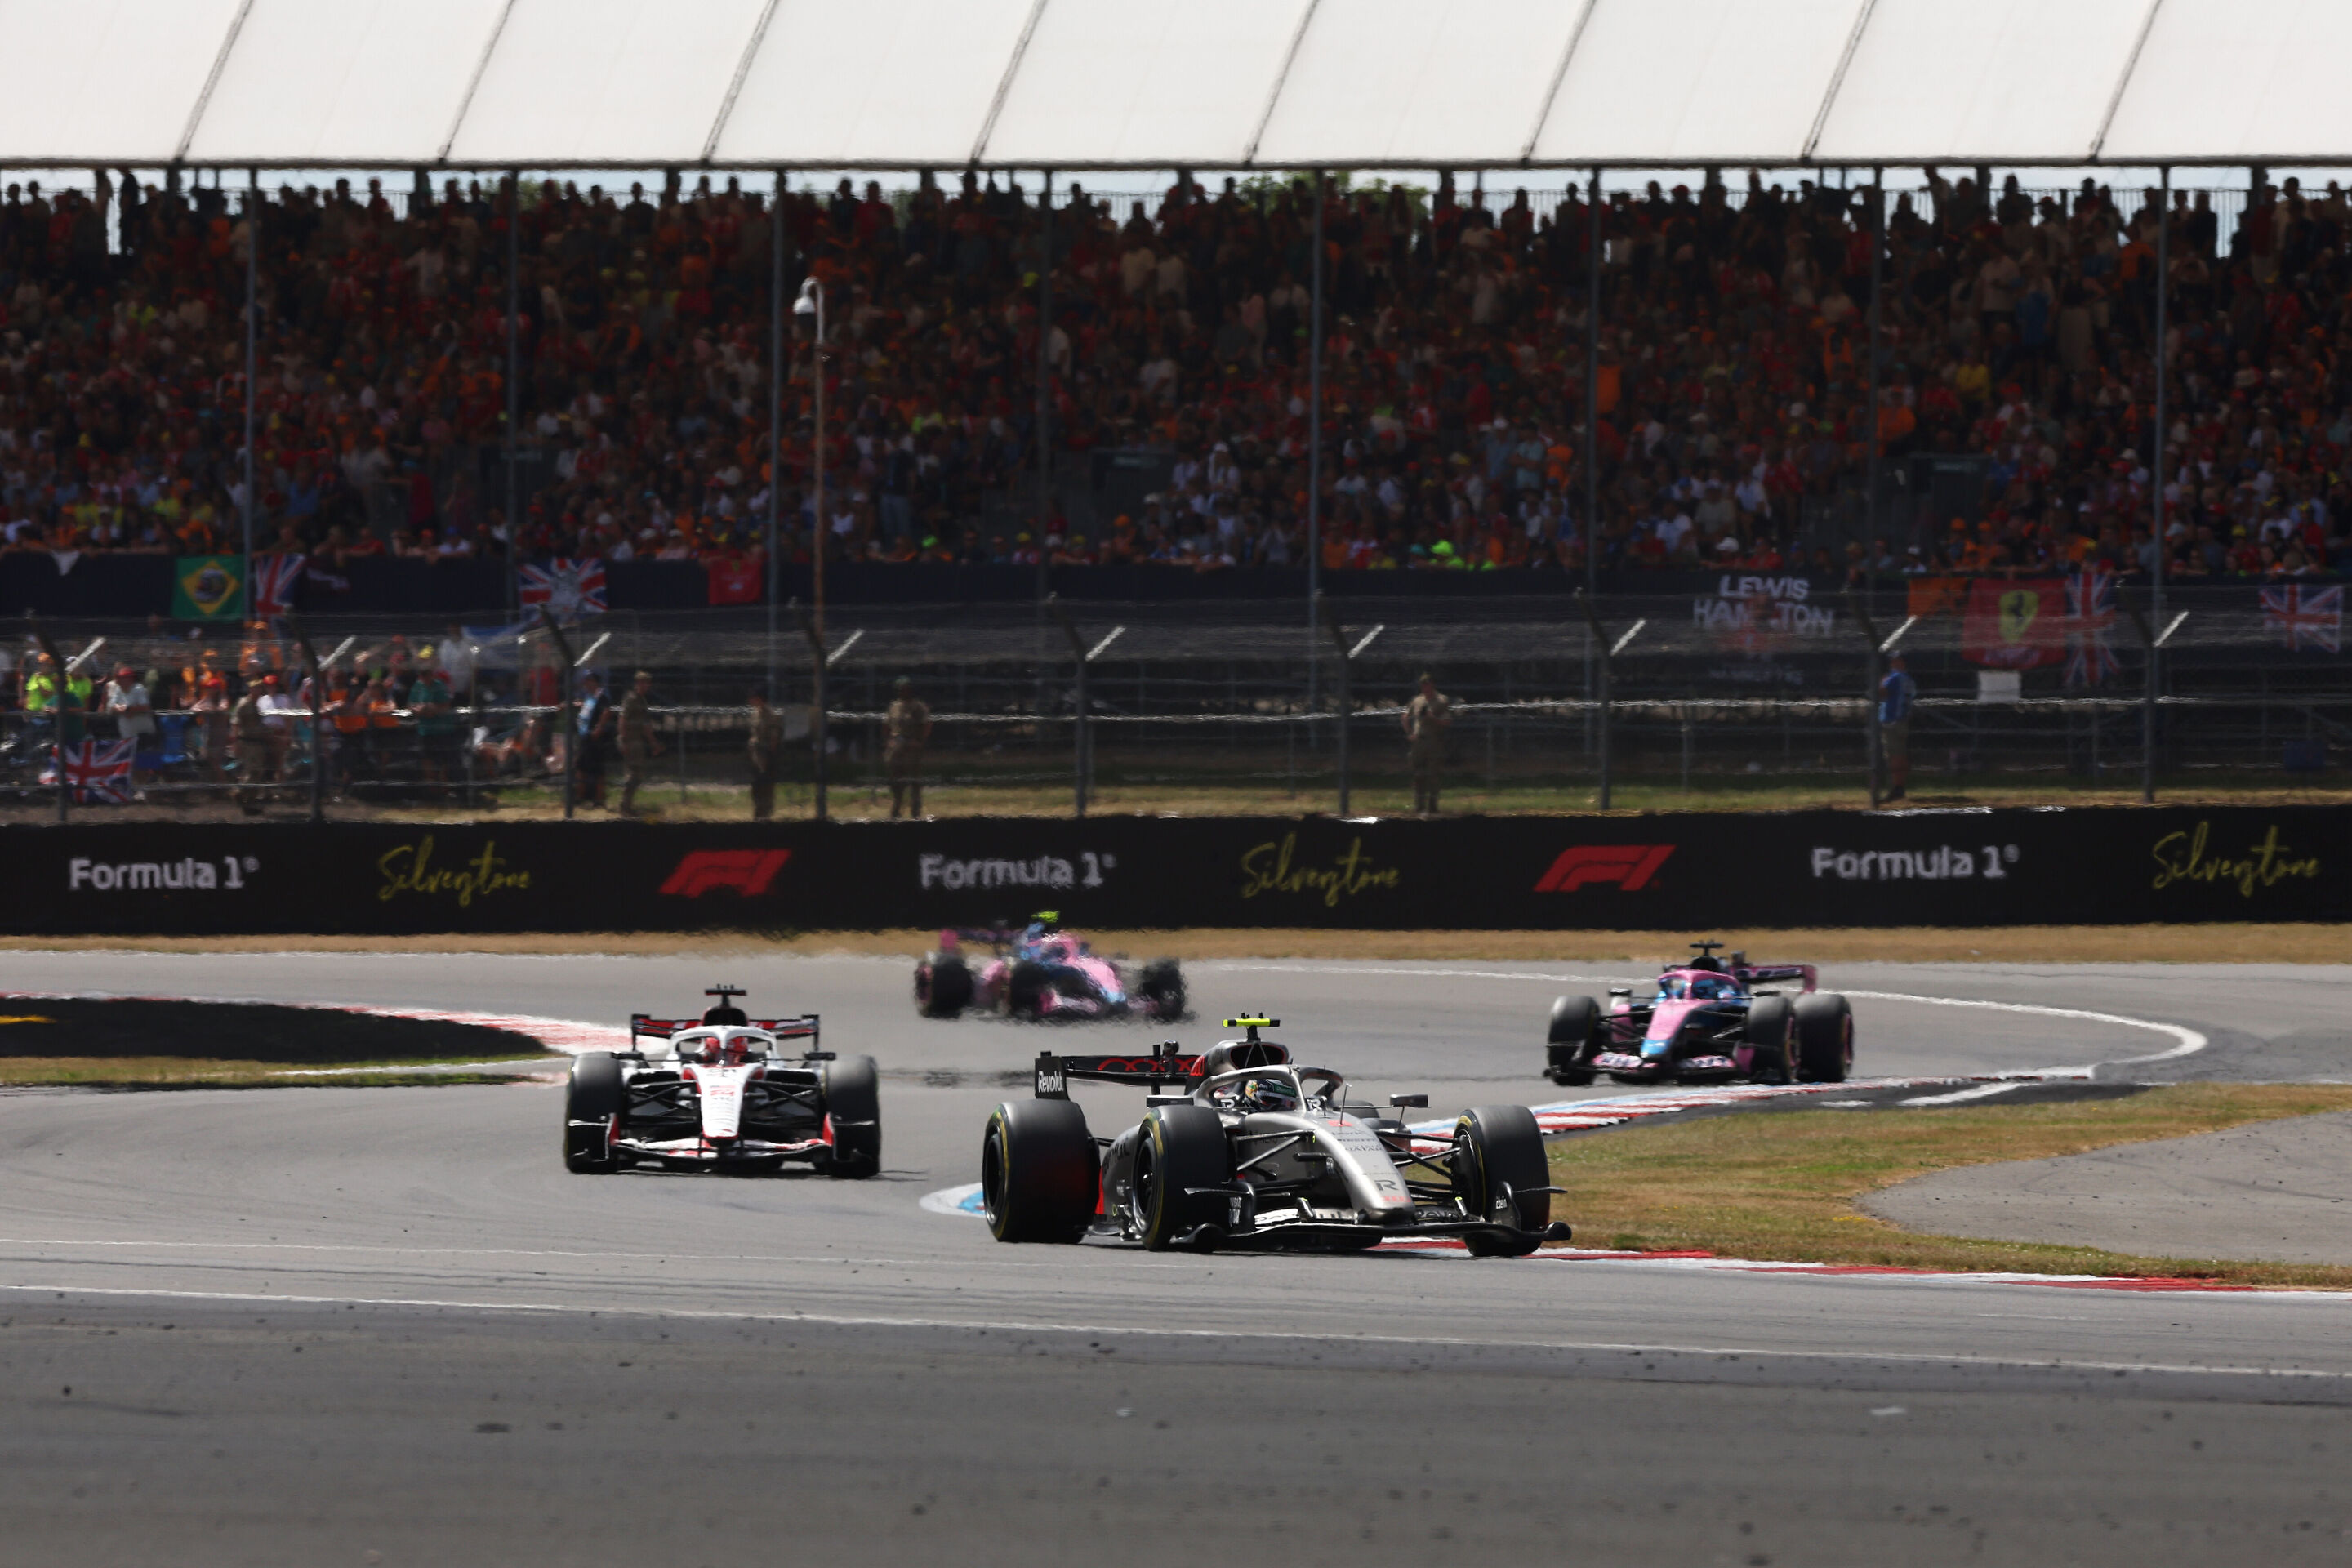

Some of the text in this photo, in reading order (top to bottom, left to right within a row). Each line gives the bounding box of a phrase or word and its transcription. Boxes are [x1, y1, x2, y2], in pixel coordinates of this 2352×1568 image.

[1719, 575, 1809, 601] LEWIS
[69, 857, 216, 890] Formula
[378, 834, 531, 906] Silverstone
[919, 853, 1073, 889] Formula
[1241, 831, 1400, 906] Silverstone
[1811, 845, 1974, 880] Formula
[2152, 820, 2321, 898] Silverstone
